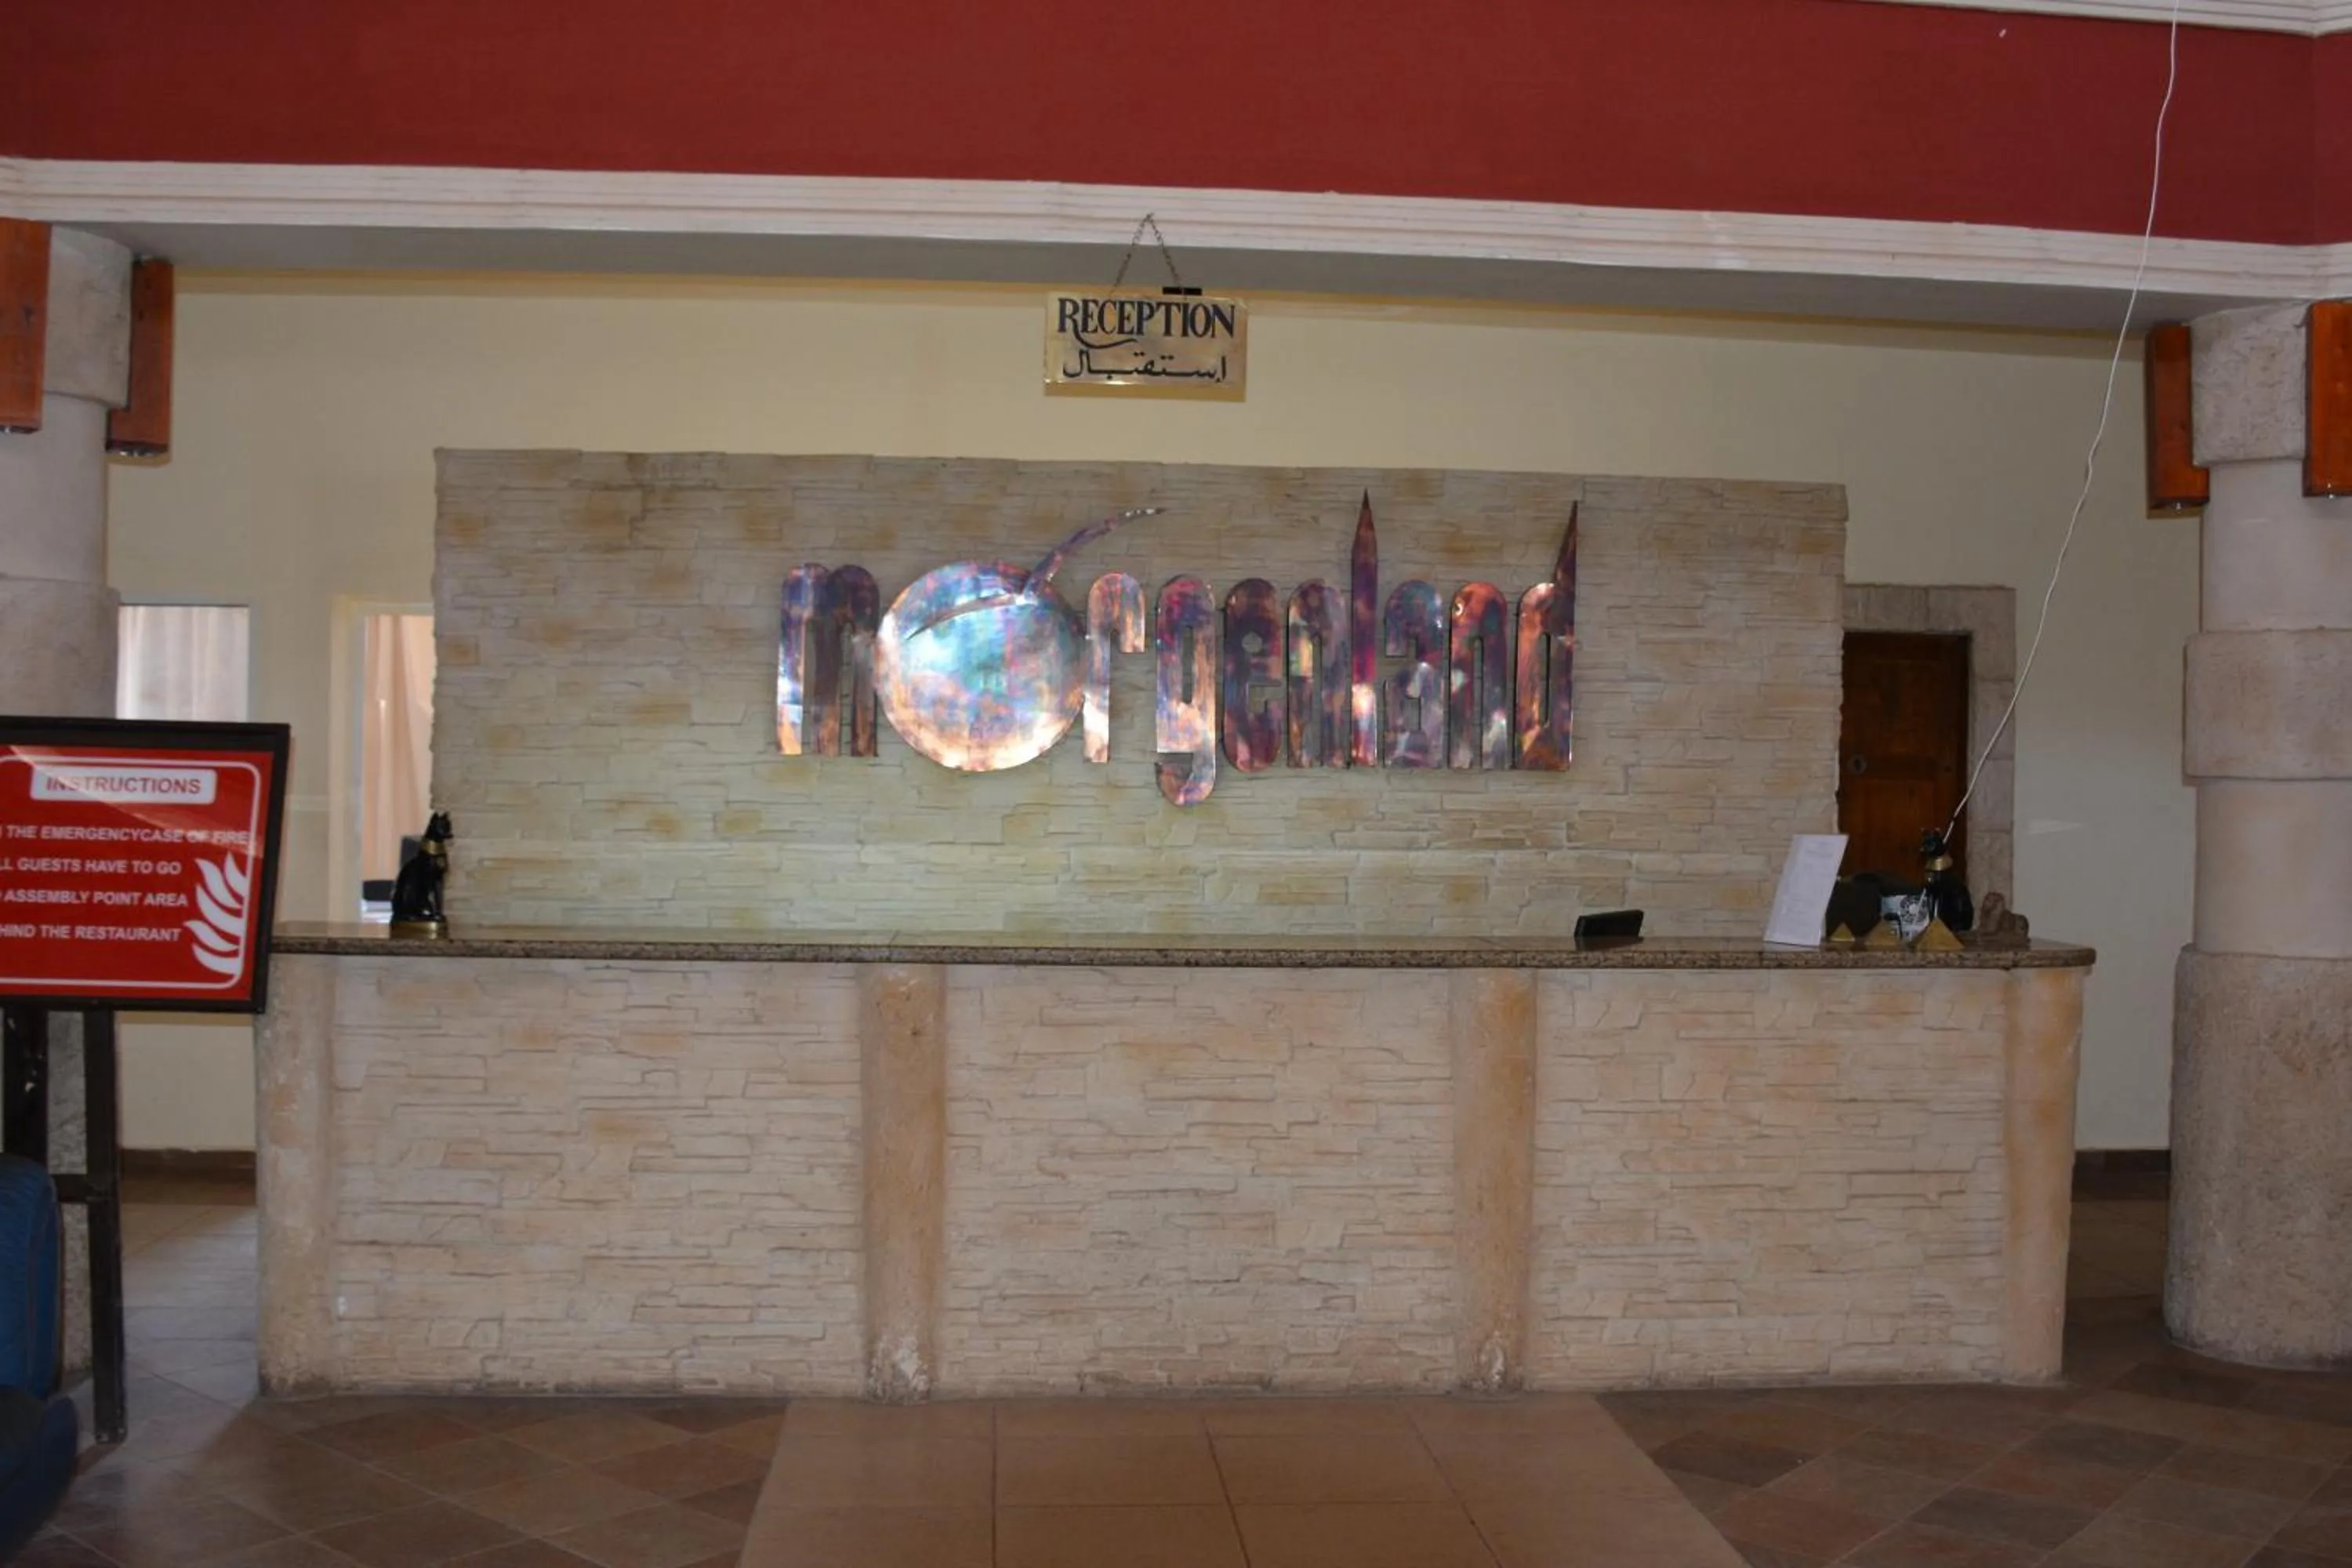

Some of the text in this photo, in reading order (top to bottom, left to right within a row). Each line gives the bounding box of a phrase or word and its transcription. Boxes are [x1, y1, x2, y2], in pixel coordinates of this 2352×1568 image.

[1058, 298, 1235, 349] RECEPTION
[46, 776, 201, 794] INSTRUCTIONS
[7, 825, 37, 838] THE
[187, 831, 209, 843] OF
[17, 858, 81, 873] GUESTS
[85, 859, 126, 873] HAVE
[132, 860, 153, 874] TO
[157, 862, 182, 875] GO
[4, 889, 90, 904] ASSEMBLY
[93, 891, 142, 906] POINT
[144, 893, 188, 907] AREA
[40, 924, 70, 938] THE
[74, 925, 182, 942] RESTAURANT
